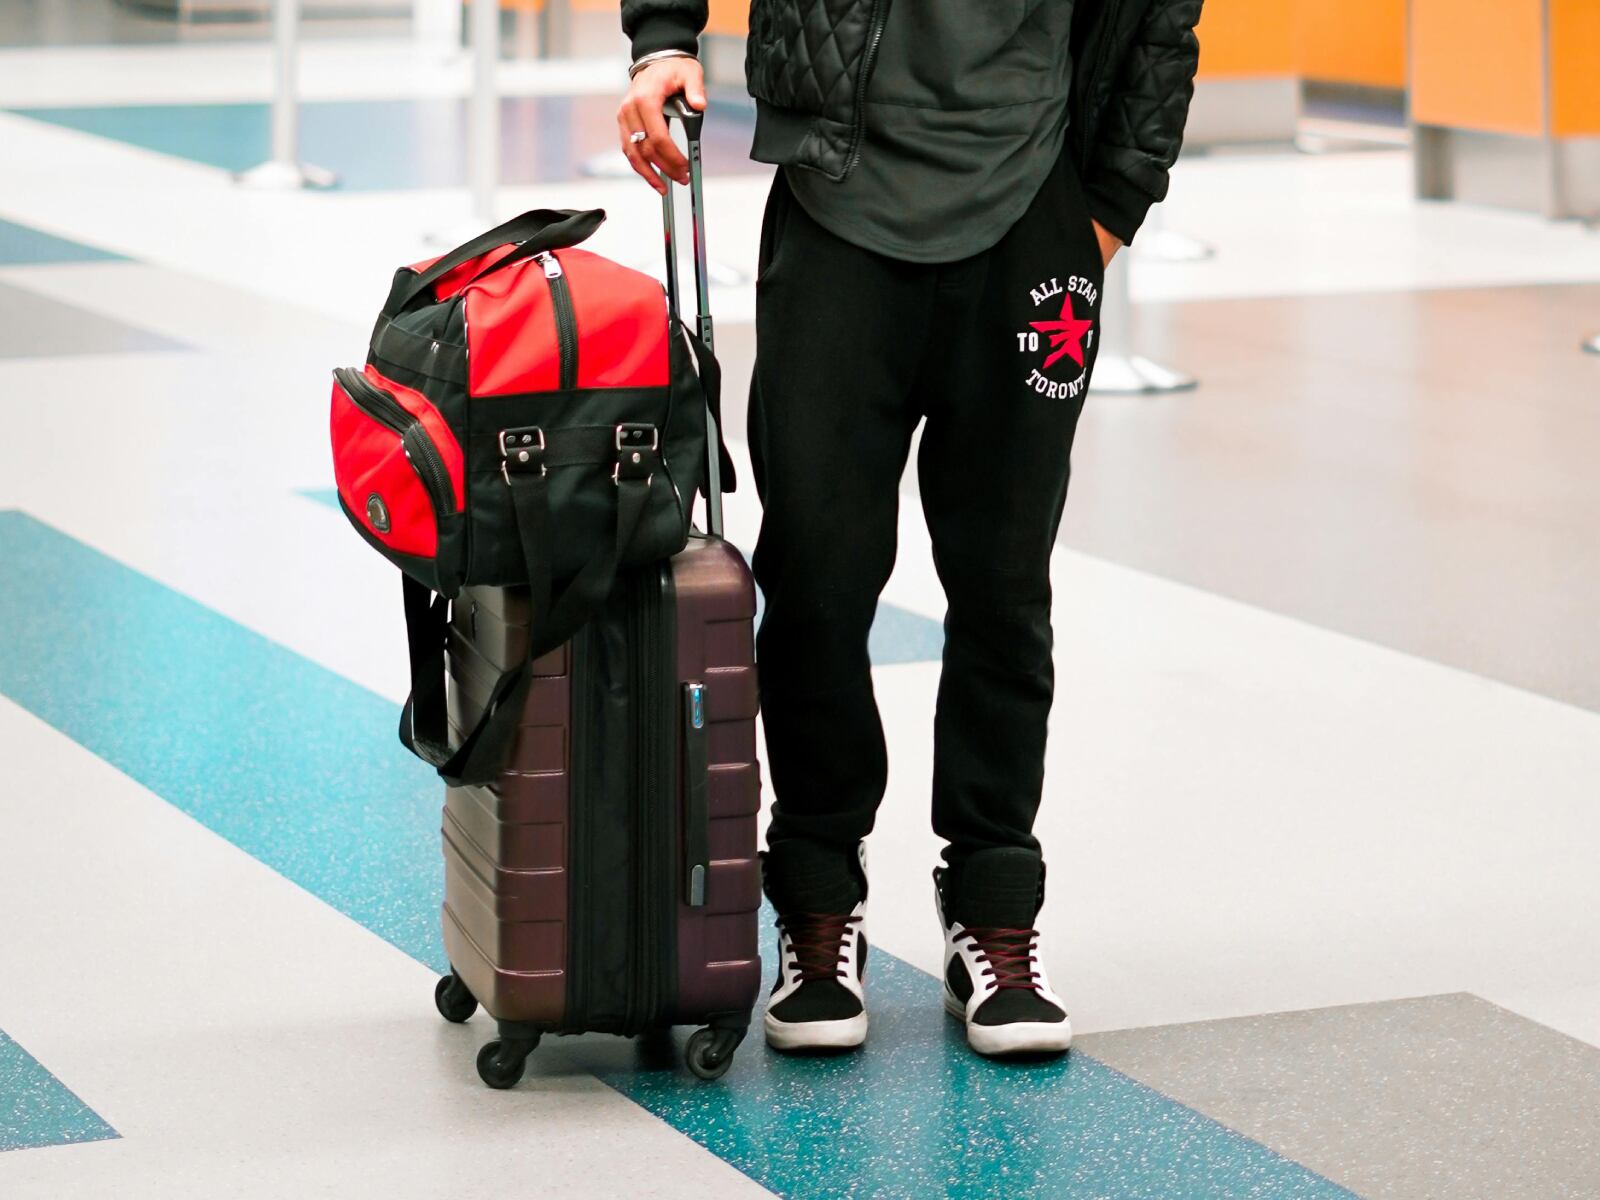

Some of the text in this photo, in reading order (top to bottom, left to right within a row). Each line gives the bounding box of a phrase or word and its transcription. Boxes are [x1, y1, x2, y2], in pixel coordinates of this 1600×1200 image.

[1029, 275, 1098, 307] ALL STAR
[1016, 331, 1039, 352] TO
[1025, 367, 1087, 400] TORONT
